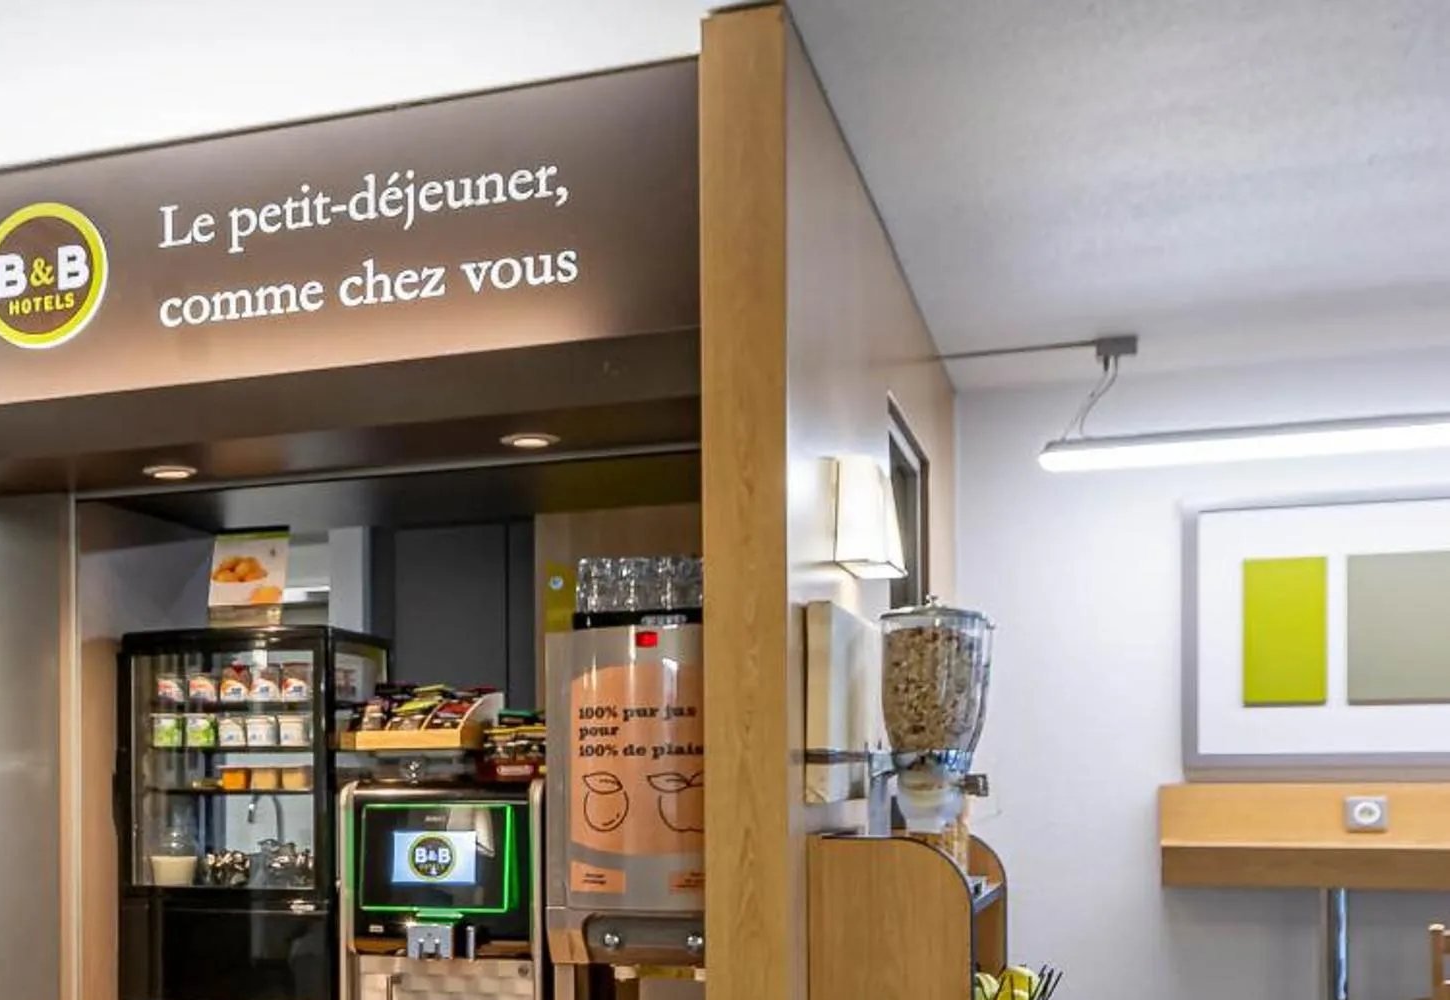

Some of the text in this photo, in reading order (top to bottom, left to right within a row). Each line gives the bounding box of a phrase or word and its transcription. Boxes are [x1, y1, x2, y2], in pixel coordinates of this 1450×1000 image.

[158, 165, 570, 254] Le petit-déjeuner,
[159, 249, 579, 328] comme chez vous
[8, 292, 75, 316] HOTELS
[578, 703, 698, 722] 100% pur jus
[578, 725, 620, 741] pour
[578, 744, 619, 758] 100%
[622, 743, 647, 757] de
